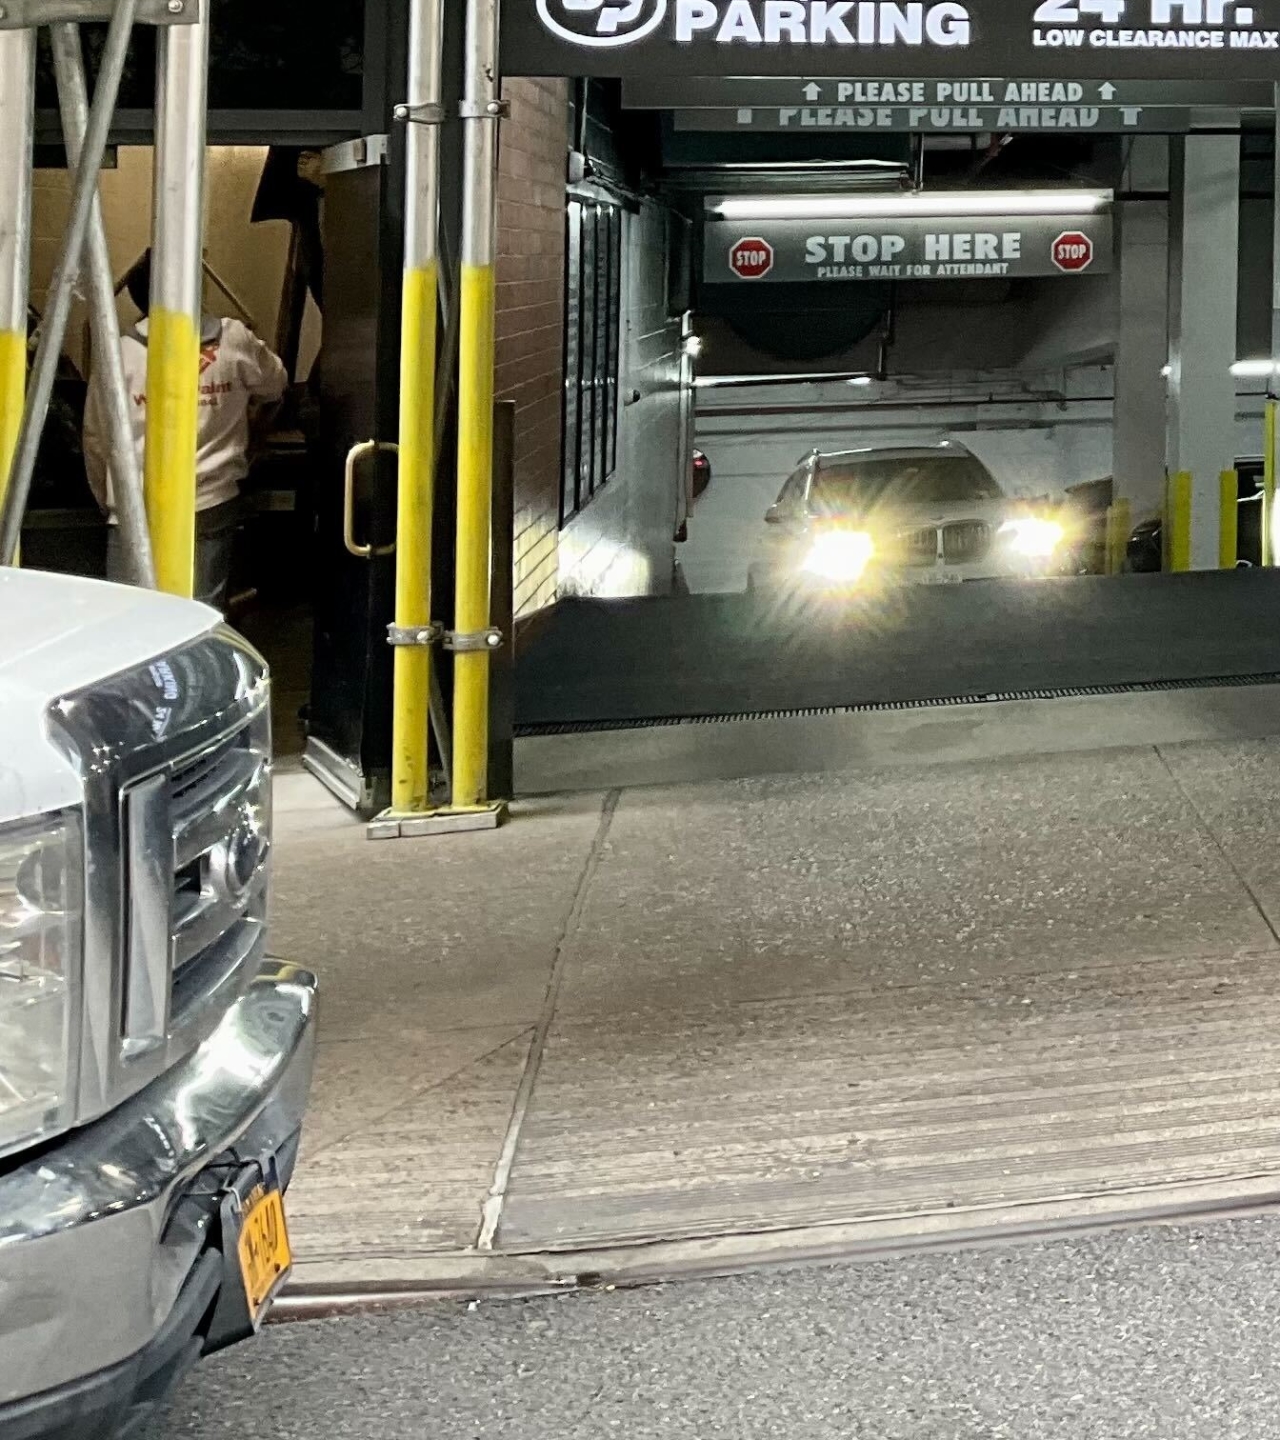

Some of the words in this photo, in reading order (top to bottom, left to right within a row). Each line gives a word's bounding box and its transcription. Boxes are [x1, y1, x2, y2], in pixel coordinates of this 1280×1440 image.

[1033, 29, 1084, 47] LOW
[1089, 29, 1224, 48] CLEARANCE
[1230, 31, 1279, 48] MAX
[837, 82, 924, 102] PLEASE
[937, 82, 994, 102] PULL
[1004, 82, 1084, 102] AHEAD
[779, 107, 892, 127] PLEASE
[909, 107, 984, 127] PULL
[997, 107, 1099, 127] AHEAD
[805, 234, 905, 264] STOP
[925, 232, 1021, 261] HERE
[1058, 243, 1088, 260] STOP
[736, 250, 766, 268] STOP
[818, 264, 863, 278] PLEASE
[869, 264, 900, 277] WAIT
[906, 263, 932, 276] FOR
[937, 262, 1009, 276] ATTENDANT
